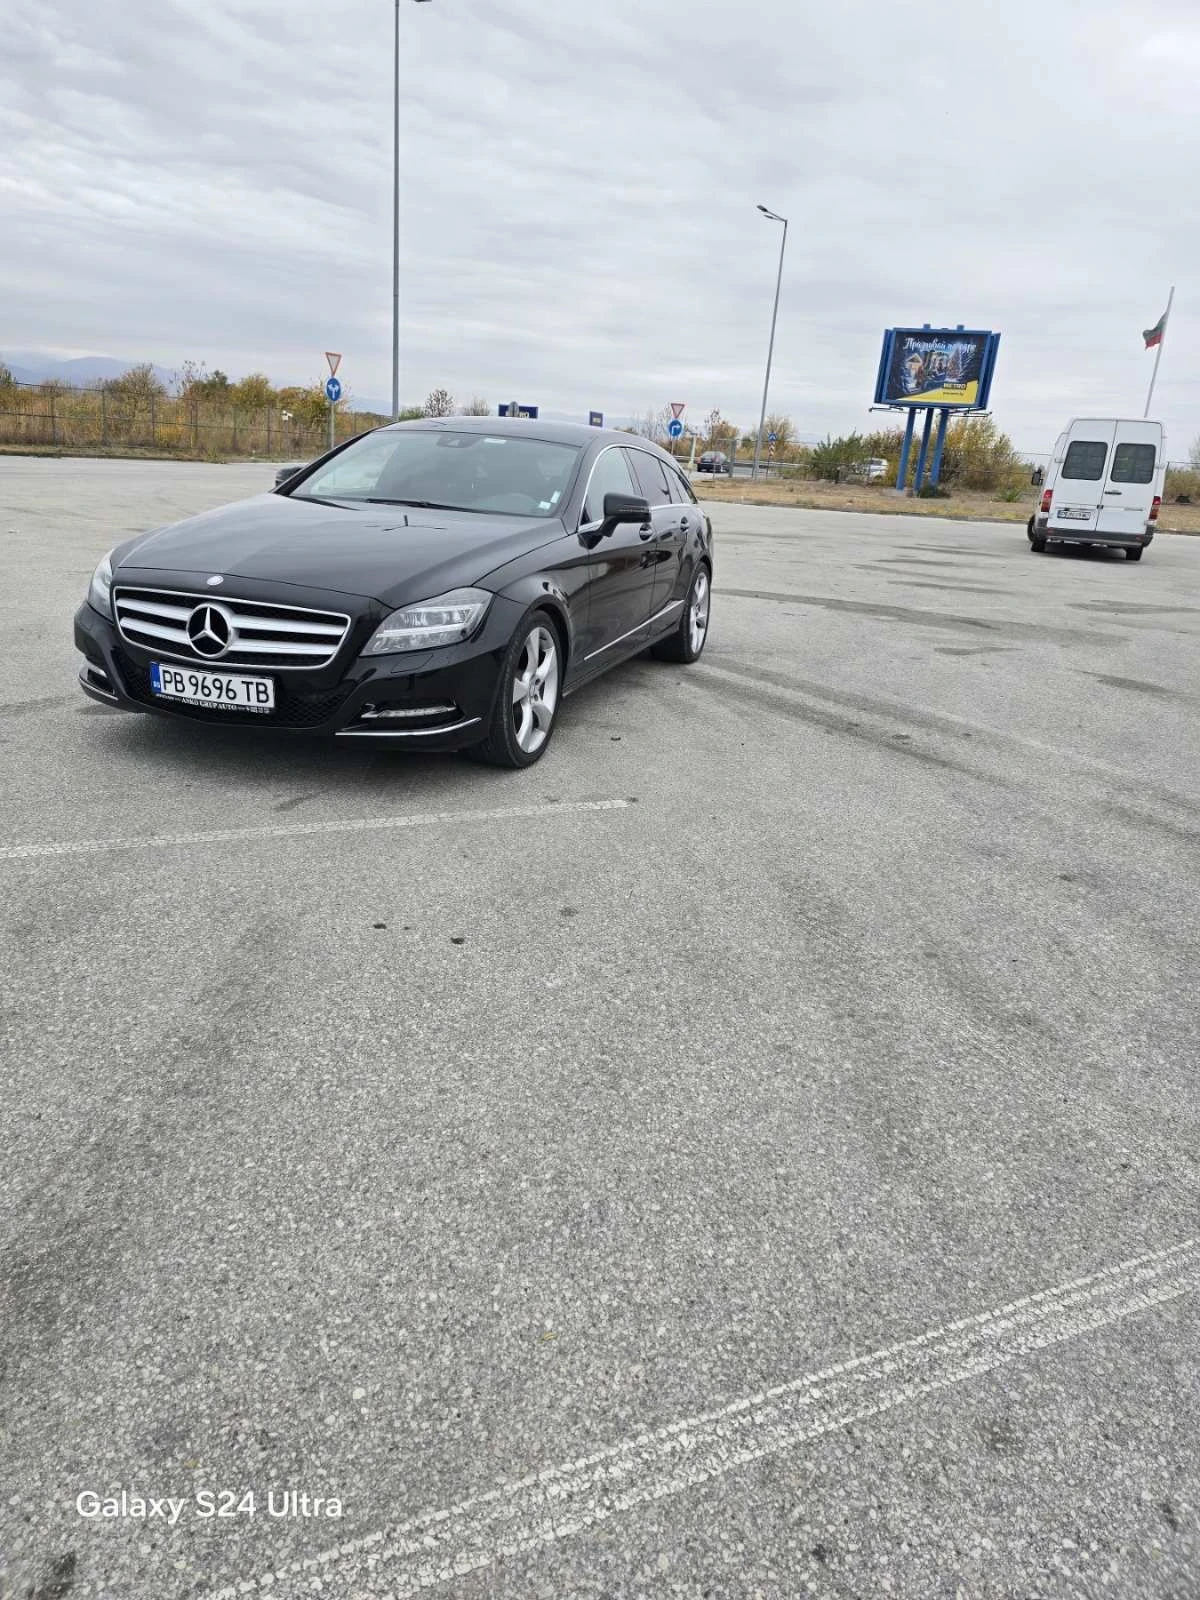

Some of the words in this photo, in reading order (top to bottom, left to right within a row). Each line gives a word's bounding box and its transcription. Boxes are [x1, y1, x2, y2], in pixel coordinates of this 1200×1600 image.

[162, 669, 186, 693] PB
[188, 674, 237, 700] 9696
[241, 680, 270, 704] TB
